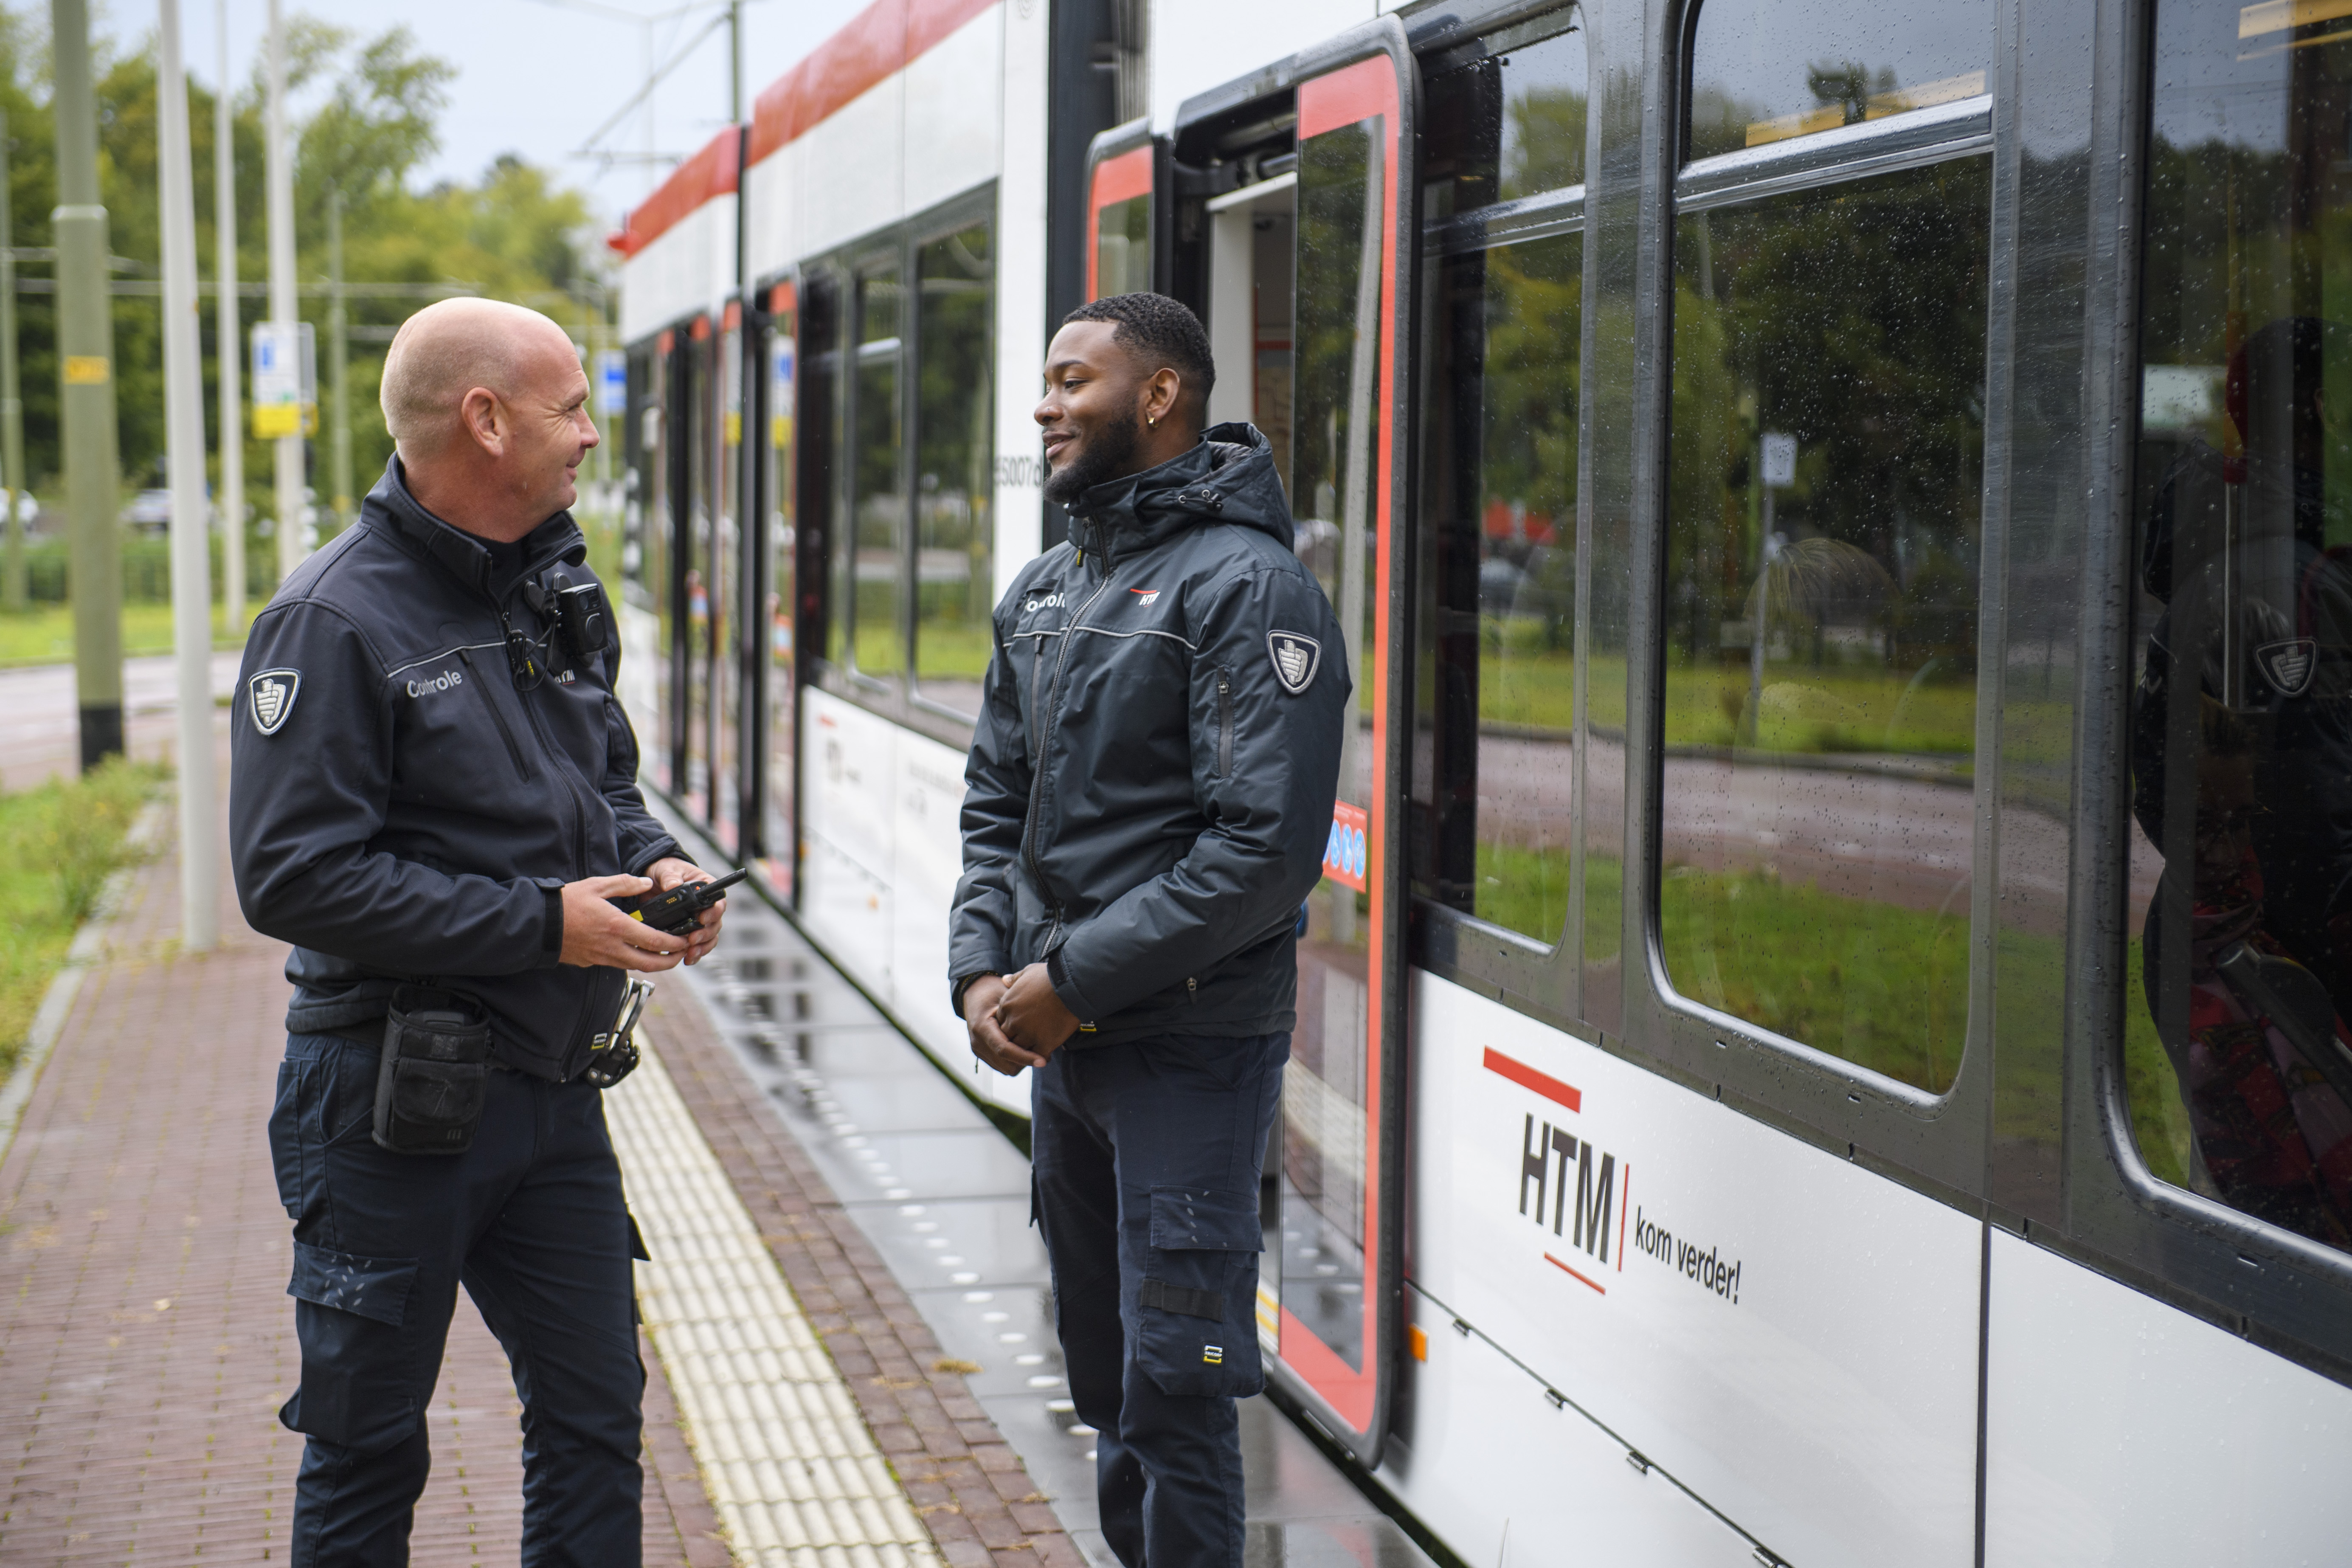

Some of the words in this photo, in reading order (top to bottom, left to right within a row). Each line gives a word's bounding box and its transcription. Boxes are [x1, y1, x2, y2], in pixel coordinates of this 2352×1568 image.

[407, 670, 462, 698] Controle
[1519, 1112, 1615, 1264] HTM
[1635, 1205, 1672, 1265] kom
[1678, 1238, 1741, 1305] verder!
